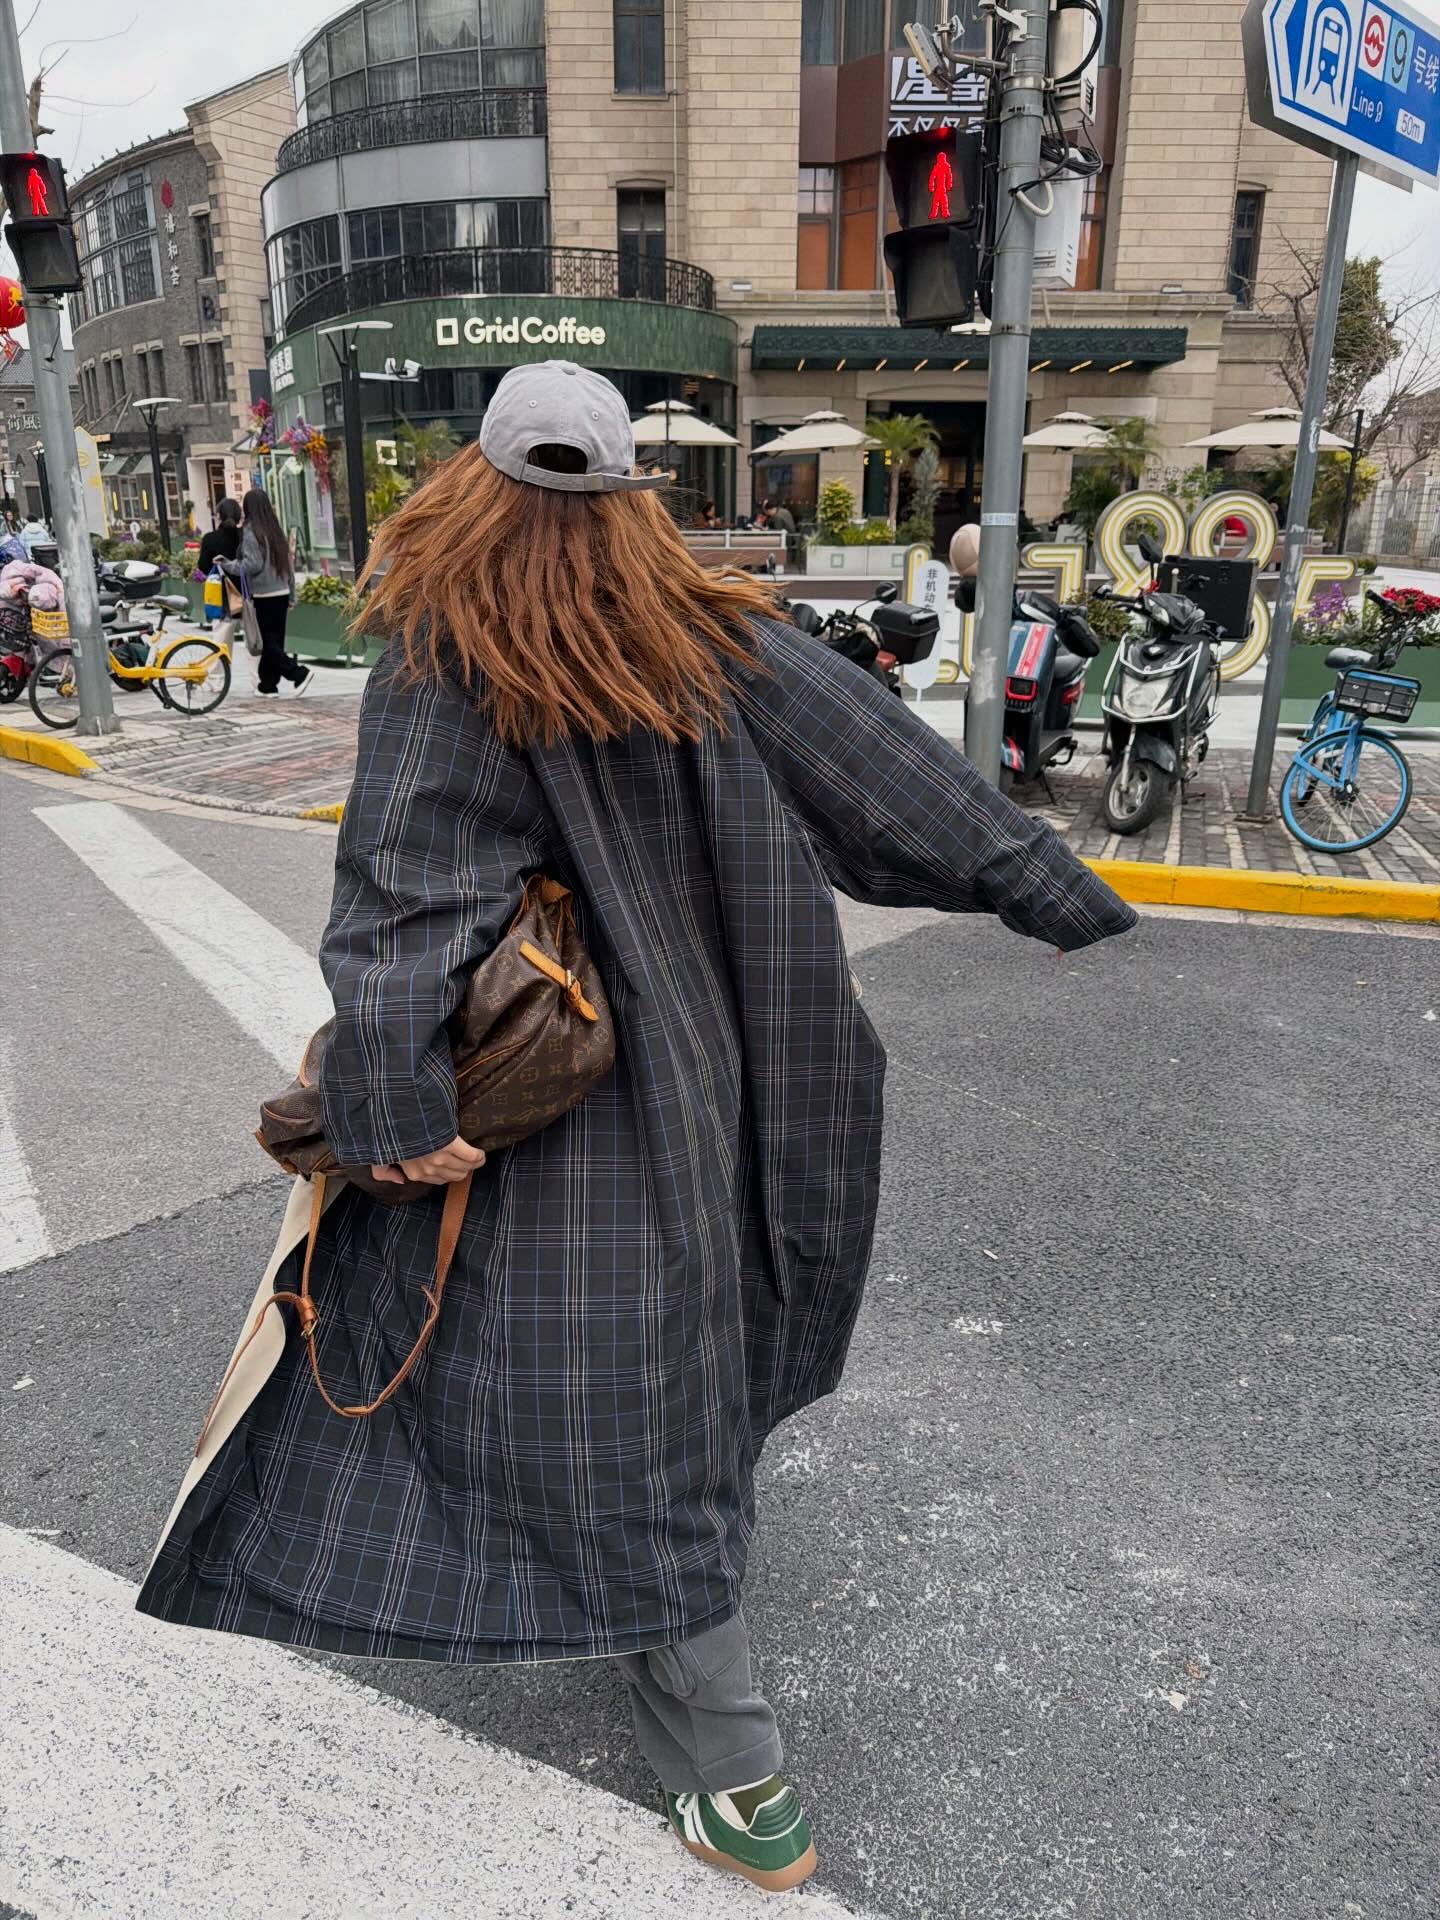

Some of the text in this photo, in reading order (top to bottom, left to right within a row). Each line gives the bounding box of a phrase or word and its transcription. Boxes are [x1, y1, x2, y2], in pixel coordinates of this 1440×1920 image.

[1352, 87, 1375, 118] Line
[1401, 113, 1421, 140] 50m
[202, 295, 215, 320] B
